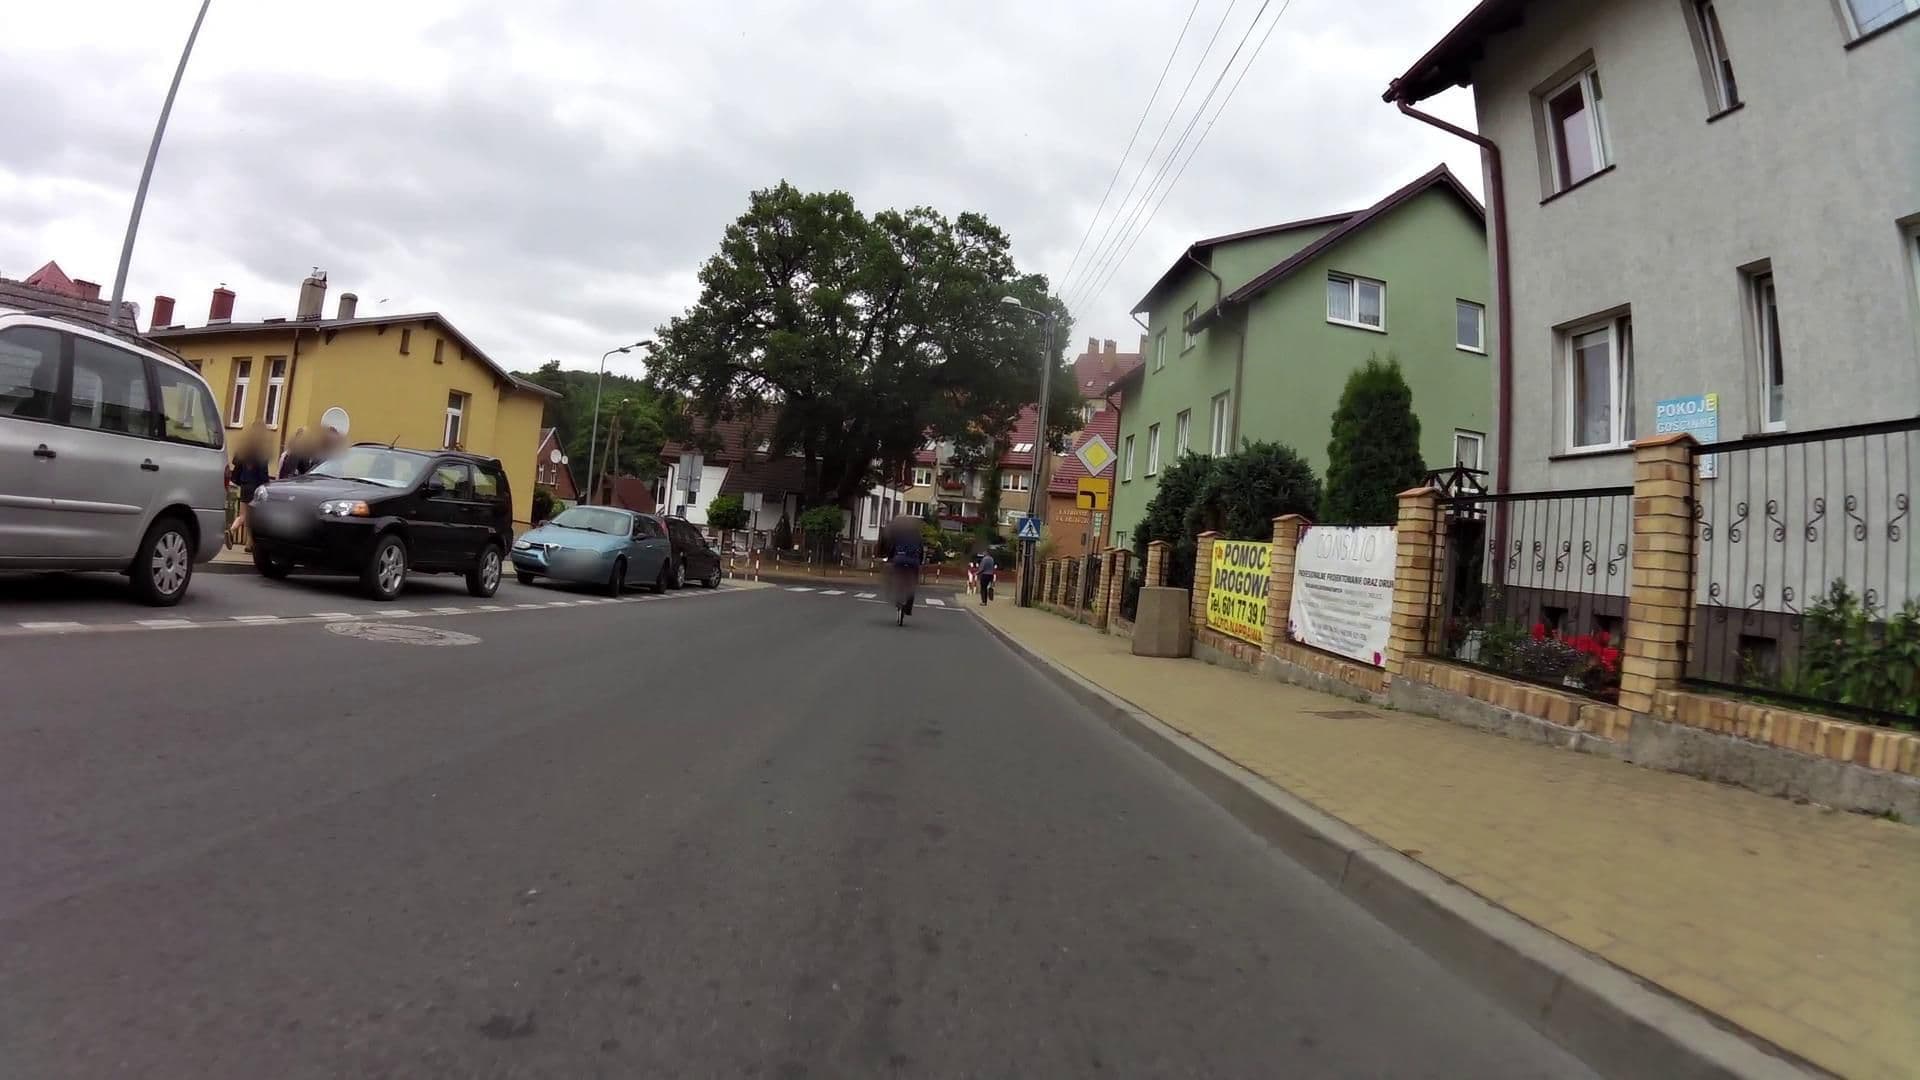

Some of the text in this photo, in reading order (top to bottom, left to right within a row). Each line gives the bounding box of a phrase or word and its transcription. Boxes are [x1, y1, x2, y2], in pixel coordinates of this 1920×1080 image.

[1657, 399, 1715, 417] POKOJE
[1224, 544, 1266, 570] POMOC
[1214, 568, 1270, 600] DROGOWA
[1363, 577, 1378, 587] ORAZ
[1222, 595, 1234, 617] 601
[1237, 598, 1247, 621] 77
[1248, 602, 1258, 624] 39
